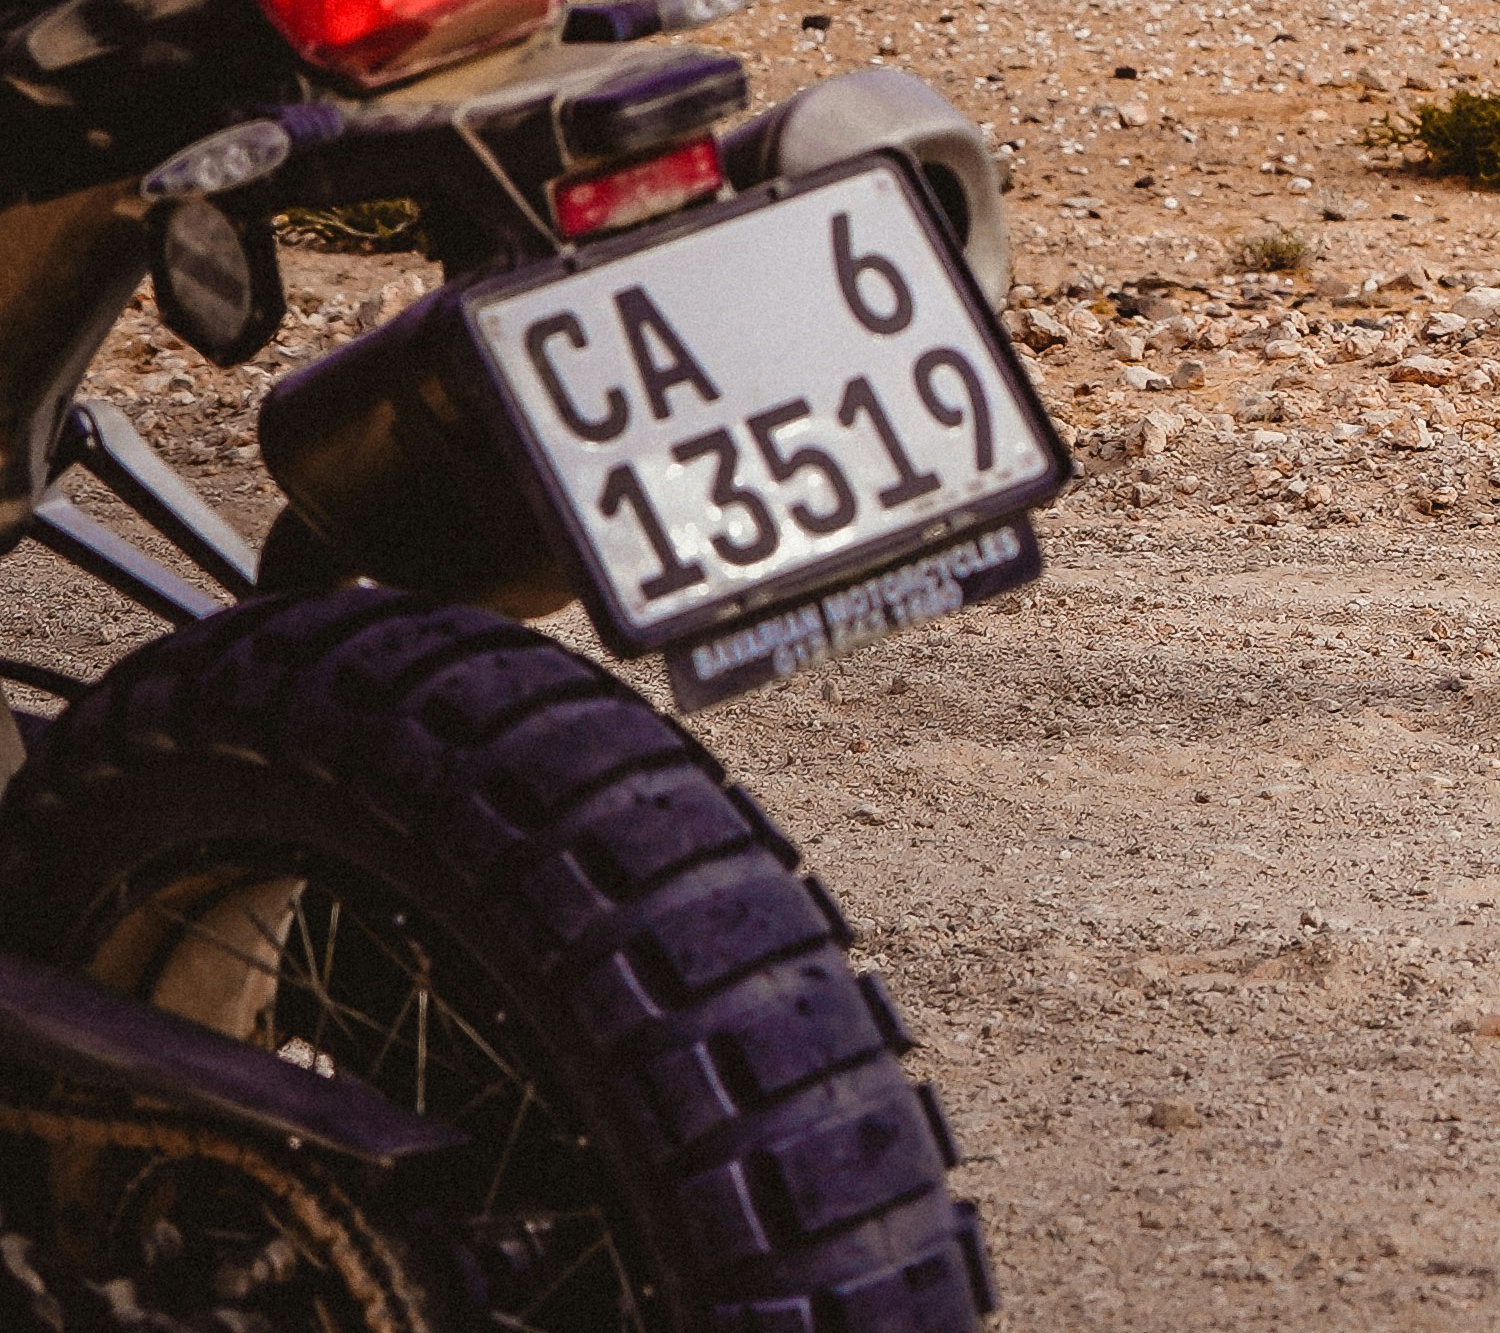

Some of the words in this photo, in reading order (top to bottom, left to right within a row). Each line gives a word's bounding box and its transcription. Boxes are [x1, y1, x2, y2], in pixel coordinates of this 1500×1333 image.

[523, 284, 721, 445] CA
[828, 212, 913, 336] 6
[598, 346, 996, 602] 13519
[822, 525, 1021, 627] MOTORCYCLES
